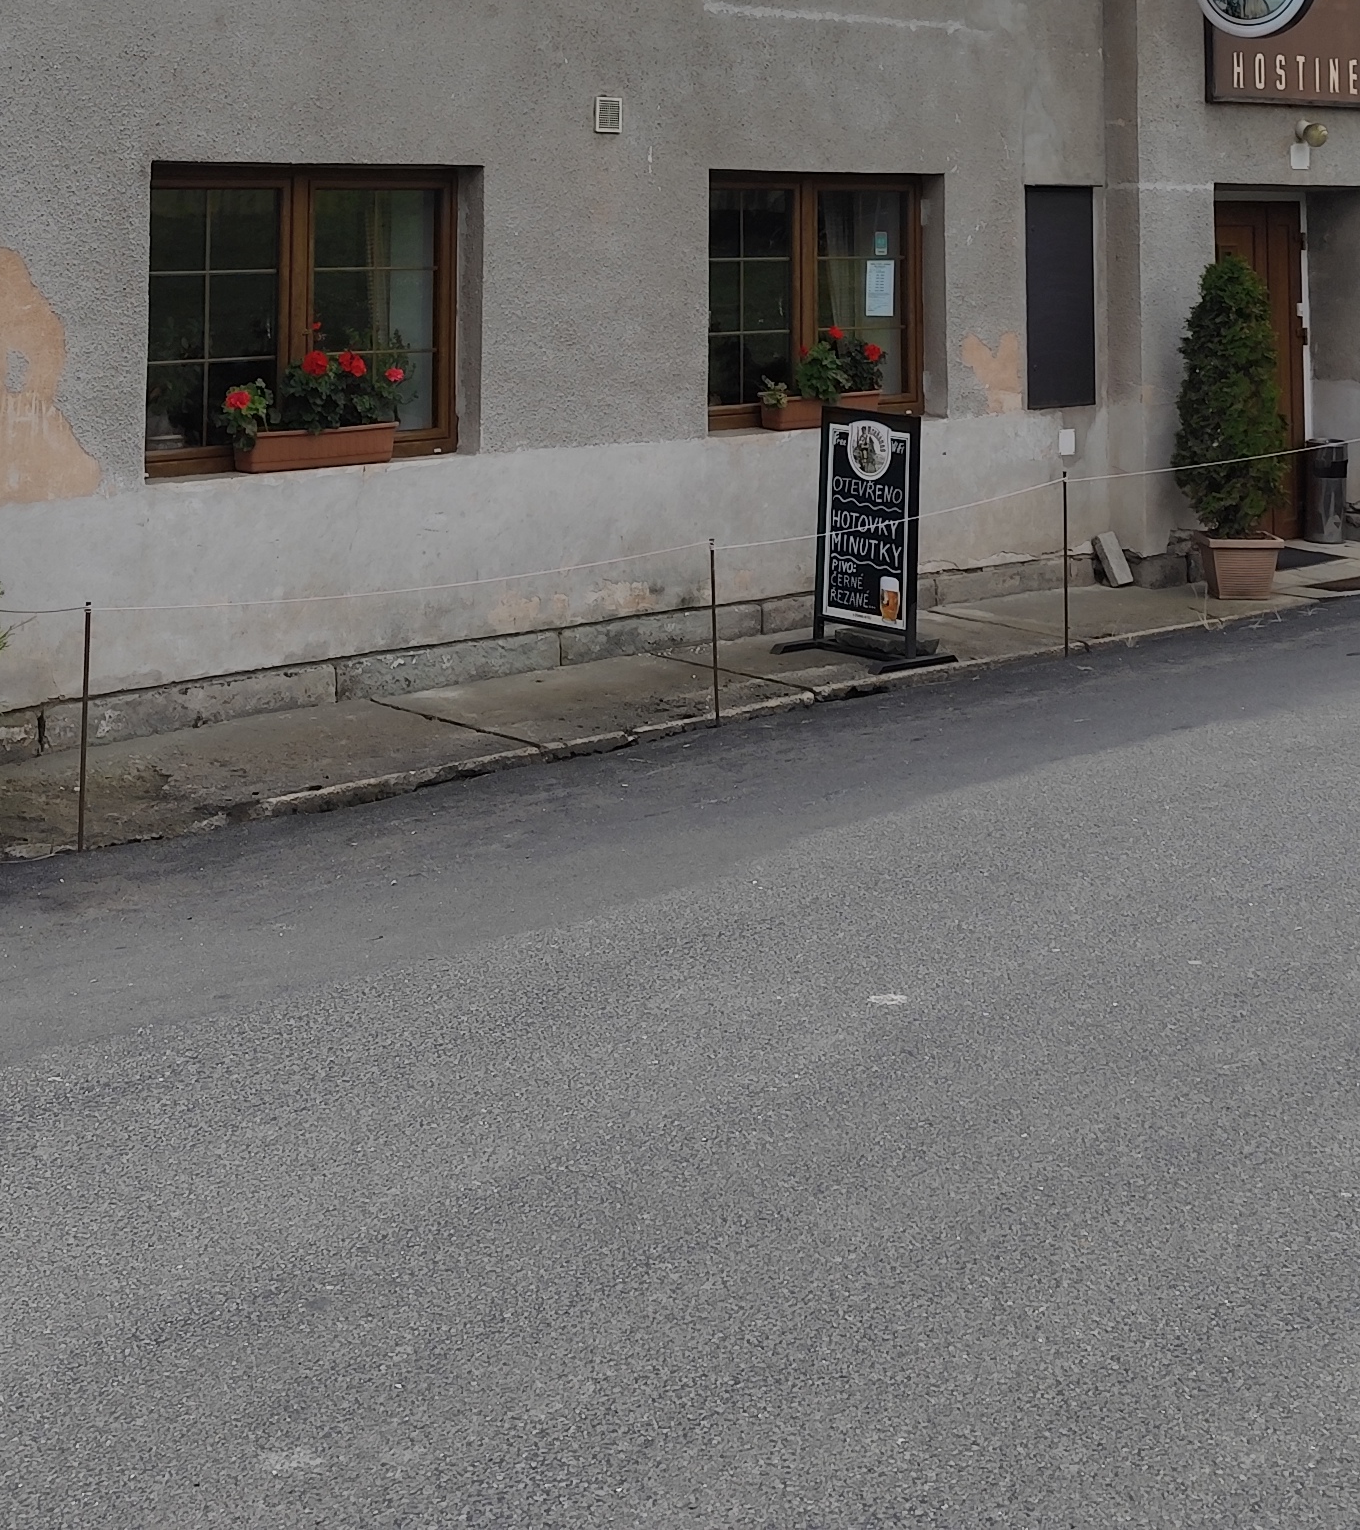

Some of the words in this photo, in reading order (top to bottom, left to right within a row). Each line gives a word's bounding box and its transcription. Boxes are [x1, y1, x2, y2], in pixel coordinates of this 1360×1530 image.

[832, 475, 903, 504] OTEVŘENO
[832, 509, 899, 540] HOTOVKY
[831, 531, 902, 568] MINUTKY
[830, 571, 864, 590] ČERNÉ
[831, 559, 857, 573] PIVO:
